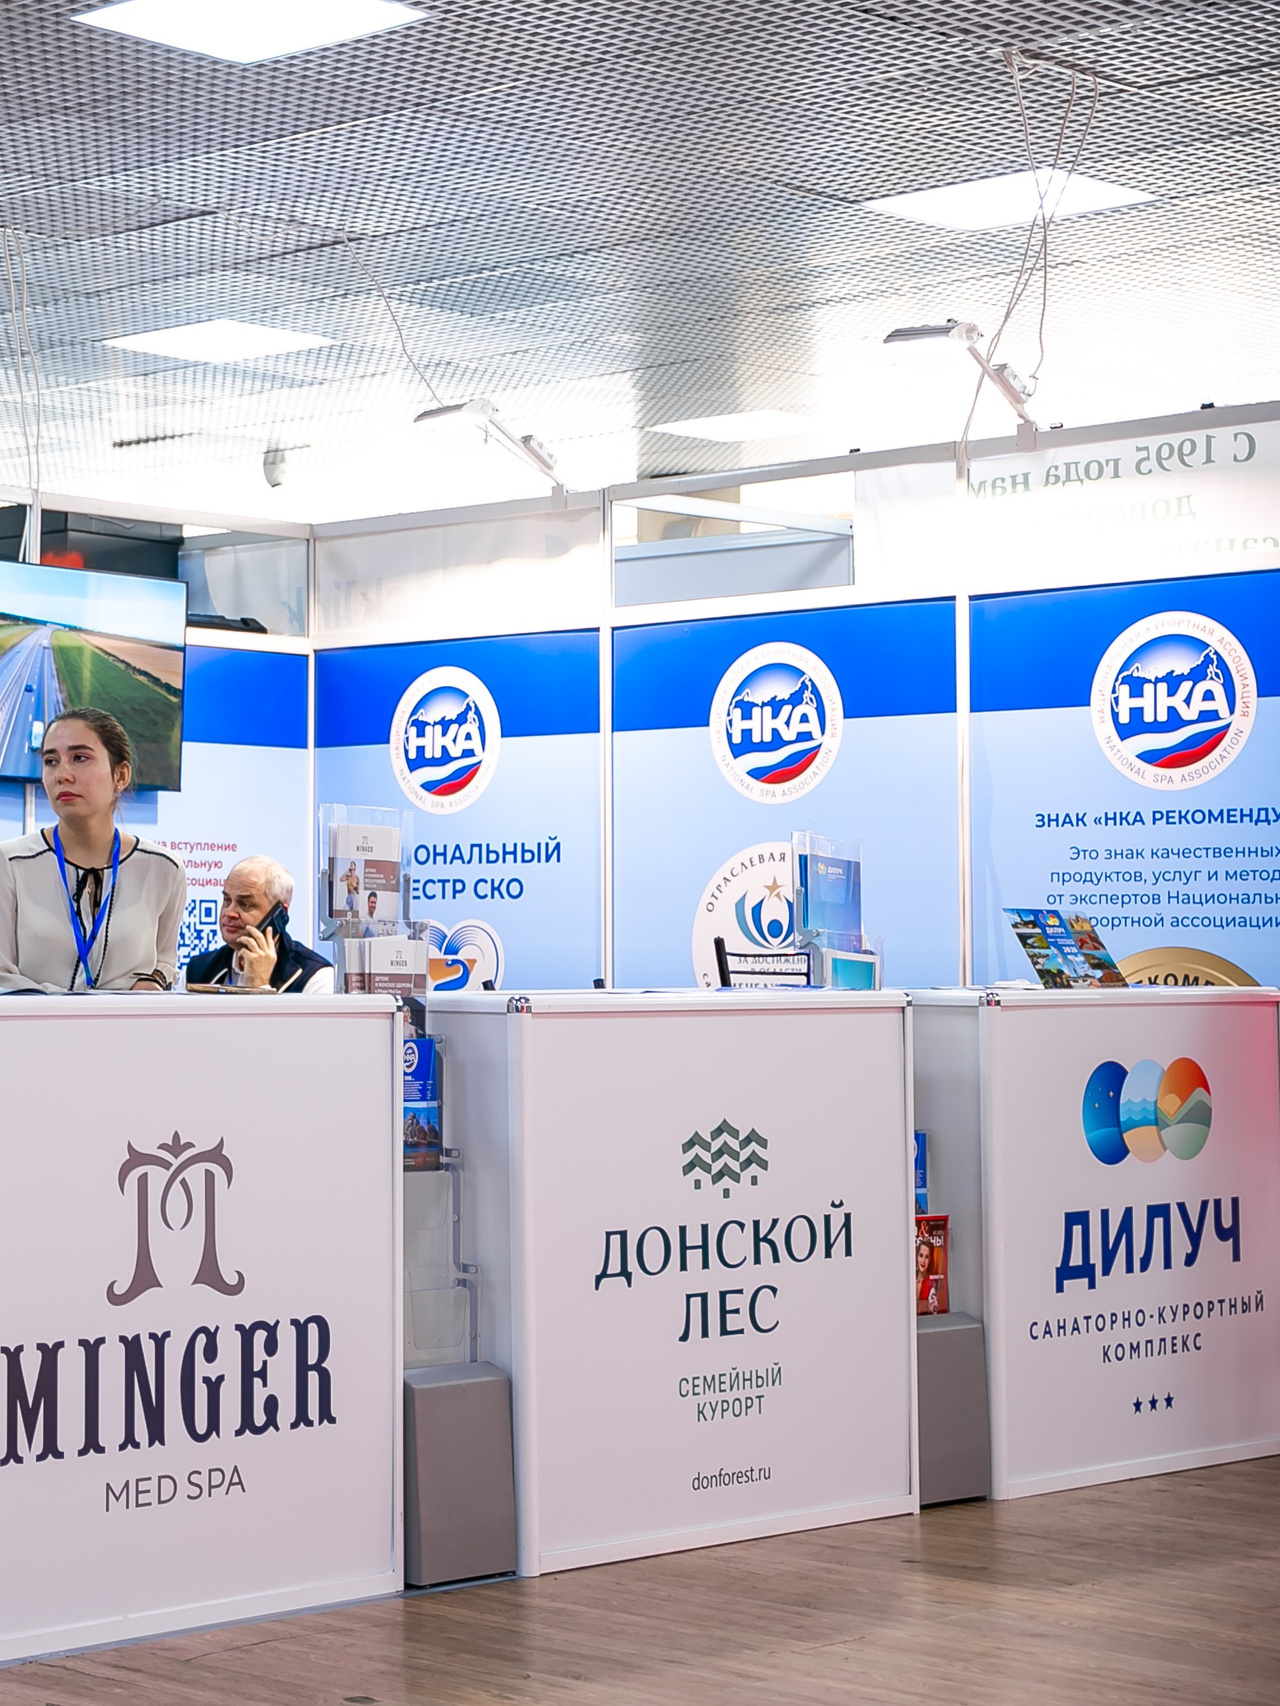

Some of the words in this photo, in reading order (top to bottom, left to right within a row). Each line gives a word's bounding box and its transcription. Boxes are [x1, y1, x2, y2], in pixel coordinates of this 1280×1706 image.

[1217, 636, 1251, 718] АССОЦИАЦИЯ
[720, 753, 755, 794] NATIONAL
[759, 788, 777, 799] SPA
[781, 748, 833, 797] ASSOCIATION
[1104, 735, 1147, 780] NATIONAL
[1152, 772, 1175, 785] SPA
[1180, 728, 1244, 784] ASSOCIATION
[430, 800, 445, 810] SPA
[1035, 812, 1088, 829] ЗНАК
[170, 841, 238, 853] вступление
[413, 836, 562, 866] ОНАЛЬНЫЙ
[1069, 846, 1100, 861] Это
[1104, 849, 1146, 861] знак
[473, 877, 525, 900] СКО
[705, 852, 787, 913] ОТРАСЛЕВАЯ
[1050, 870, 1148, 887] продуктов,
[1151, 868, 1203, 886] услуг
[1207, 870, 1218, 882] и
[1046, 894, 1065, 906] от
[1069, 892, 1162, 909] экспертов
[594, 1199, 854, 1291] ДОНСКОЙ
[1054, 1196, 1241, 1294] ДИЛУЧ
[678, 1284, 780, 1343] ЛЕС
[1029, 1289, 1265, 1341] САНАТОРНО-КУРОРТНЫЙ
[1102, 1332, 1203, 1364] КОМПЛЕКС
[0, 1314, 337, 1467] MINGER
[678, 1361, 783, 1398] СЕМЕЙНЫЙ
[697, 1395, 765, 1423] КУРОРТ
[105, 1474, 178, 1512] MED
[185, 1465, 247, 1501] SPA
[691, 1466, 772, 1491] donforest.ru
